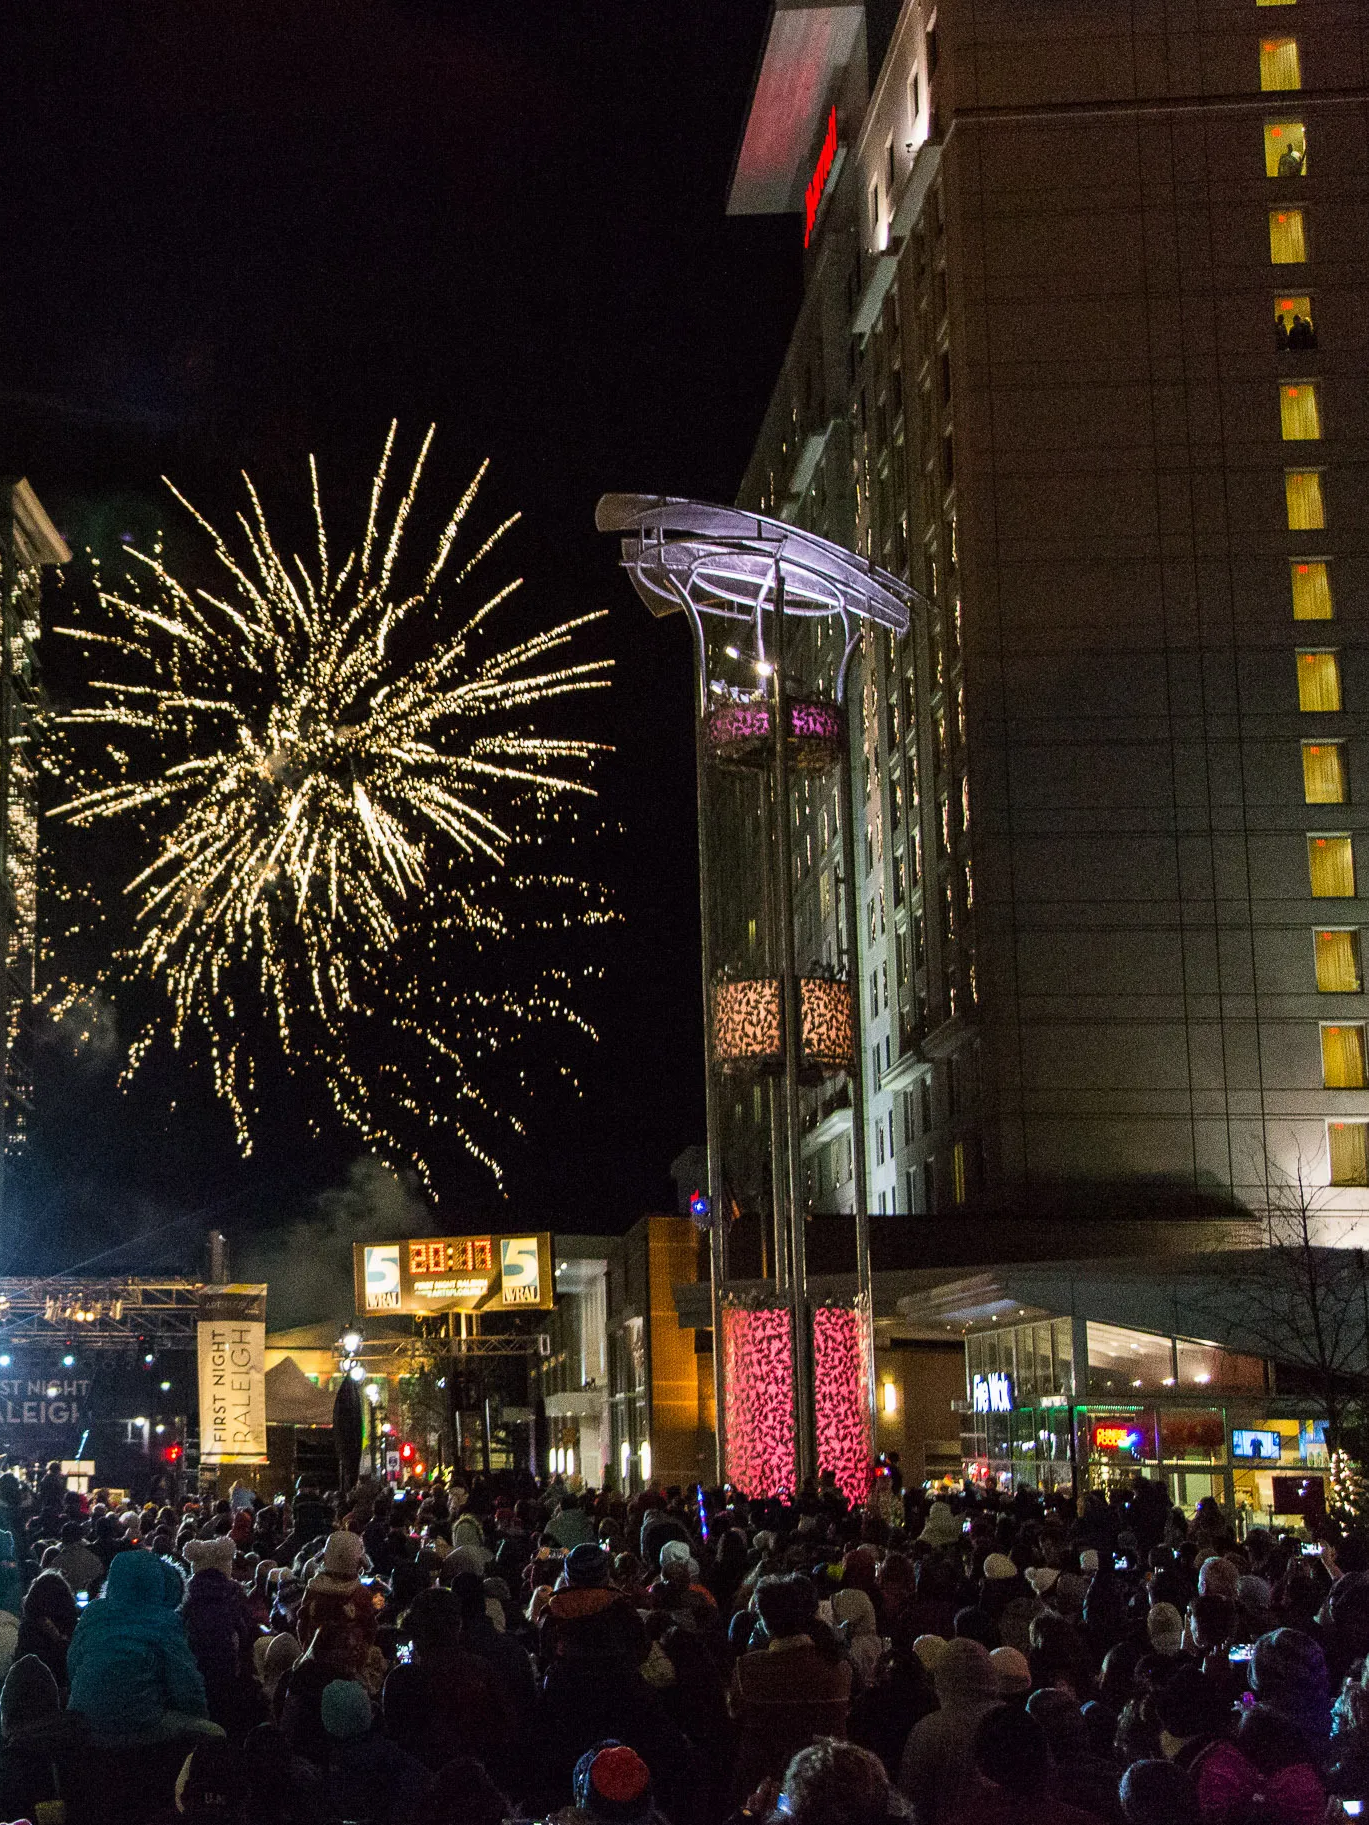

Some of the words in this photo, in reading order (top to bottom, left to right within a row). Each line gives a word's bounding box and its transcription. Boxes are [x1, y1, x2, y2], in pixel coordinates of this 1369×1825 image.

[367, 1246, 399, 1293] 5
[504, 1238, 538, 1287] 5
[366, 1292, 400, 1309] WRAL
[503, 1286, 540, 1303] WRAL
[212, 1330, 226, 1386] NIGHT
[28, 1380, 89, 1396] NIGHT
[231, 1328, 251, 1443] RALEIGH
[213, 1394, 227, 1443] FIRST
